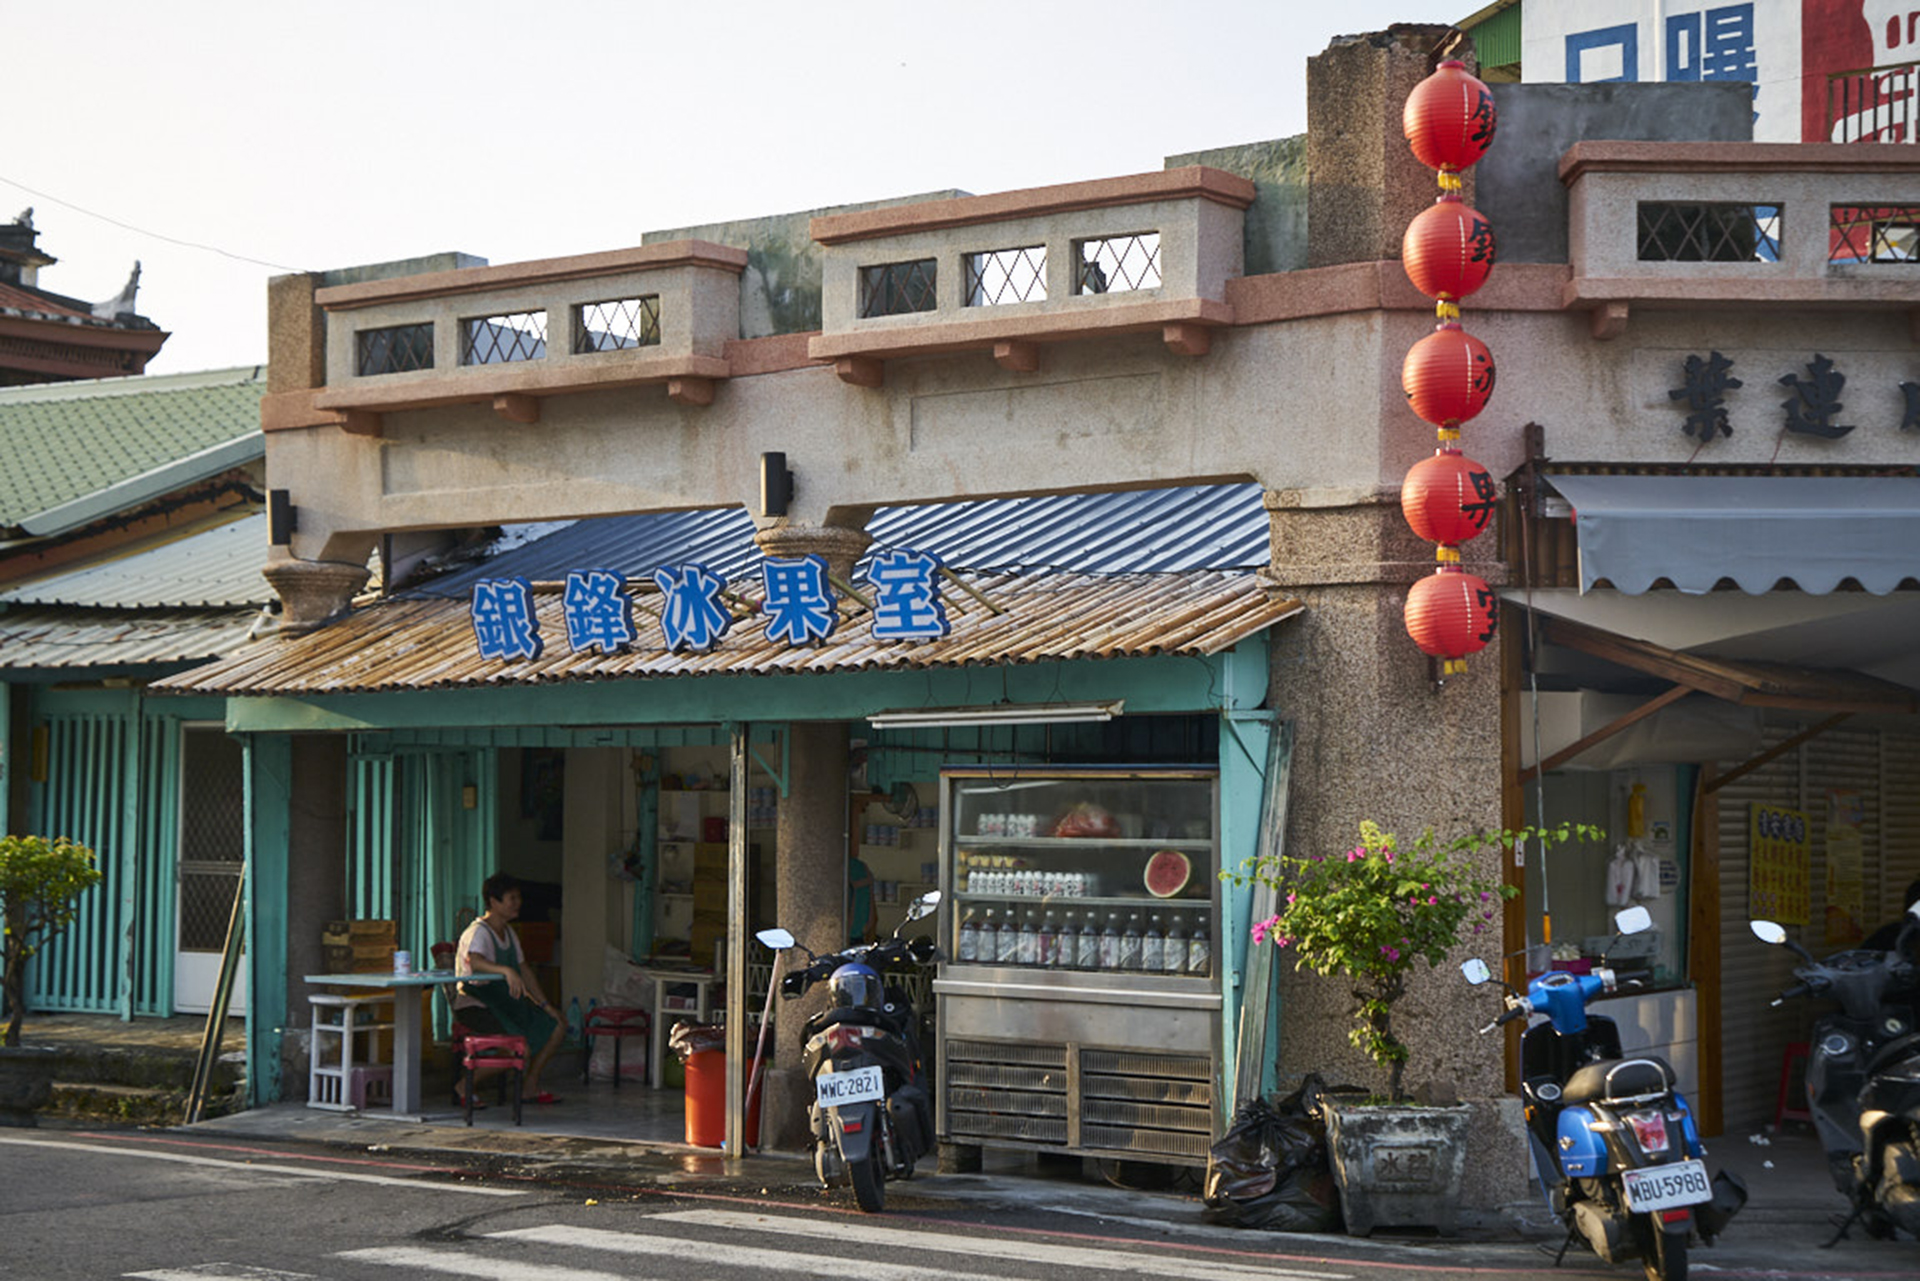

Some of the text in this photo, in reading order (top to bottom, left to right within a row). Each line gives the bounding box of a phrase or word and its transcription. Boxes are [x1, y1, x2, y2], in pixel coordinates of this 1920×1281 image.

[471, 549, 949, 660] 銀鋒冰果室
[820, 1075, 879, 1100] MWC-2821
[1629, 1172, 1707, 1203] MBU-5988
